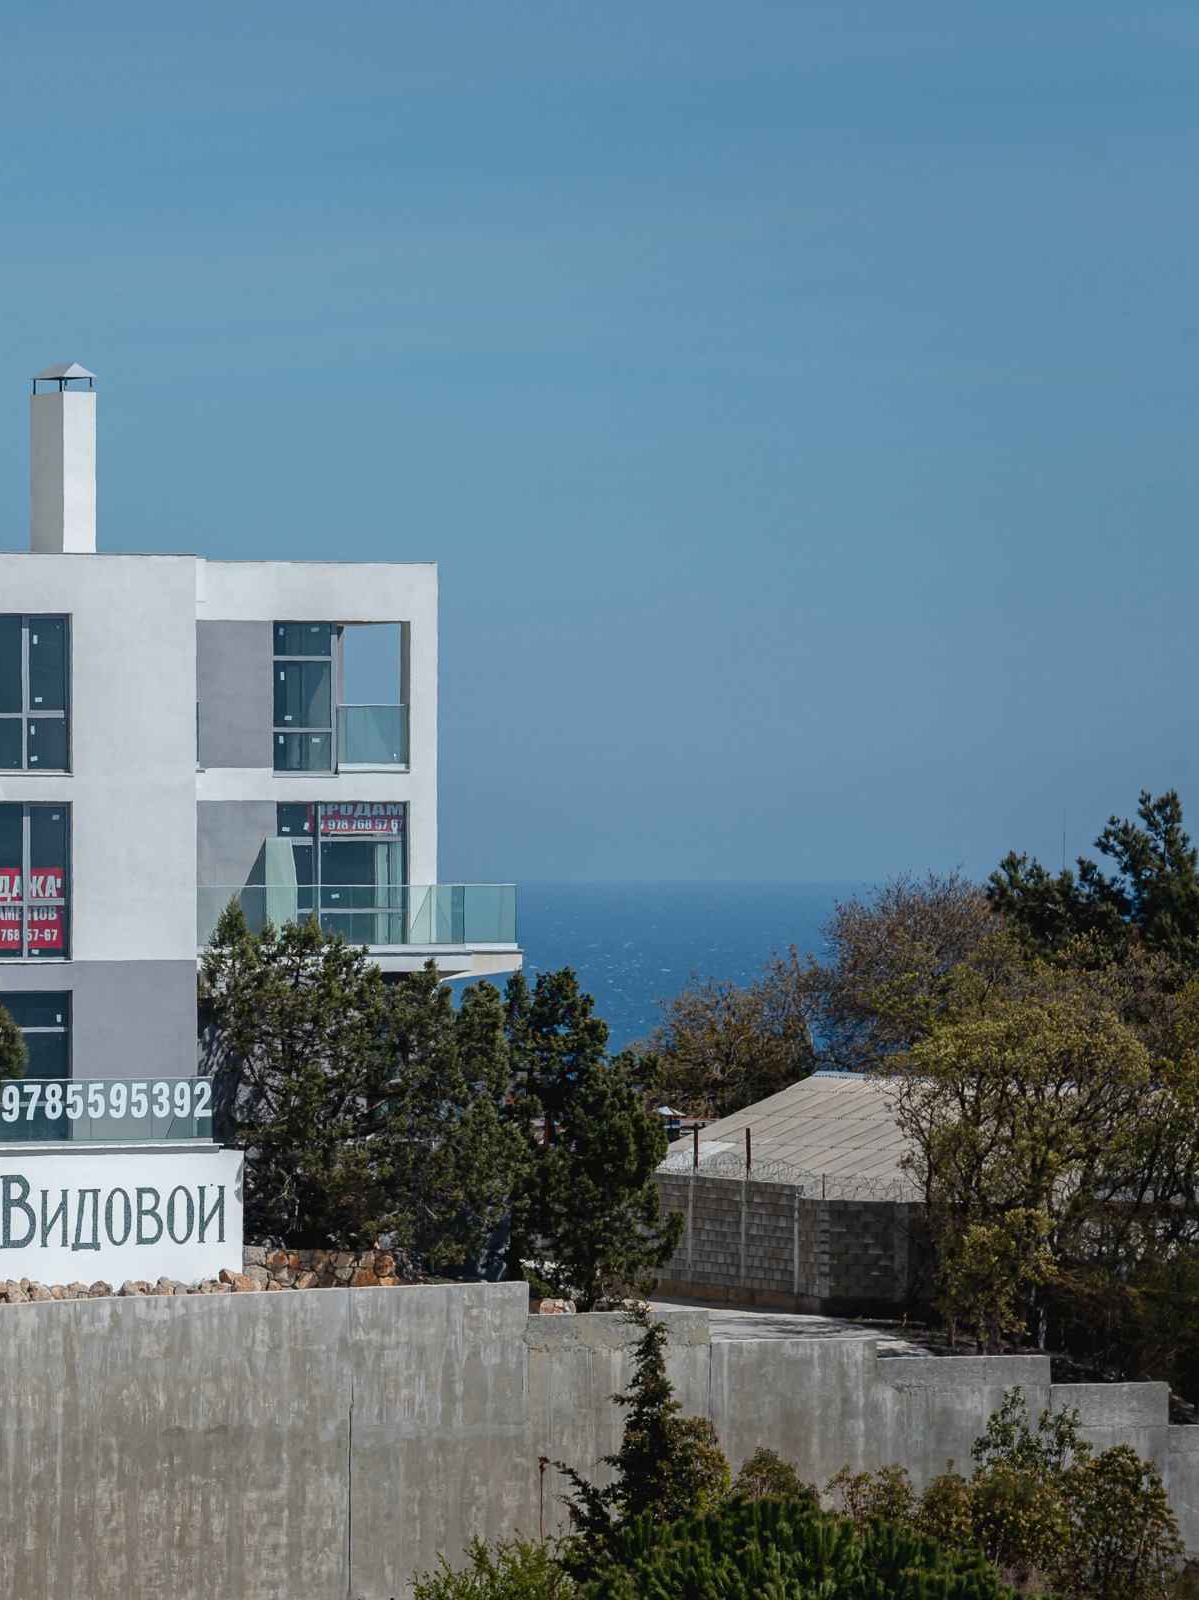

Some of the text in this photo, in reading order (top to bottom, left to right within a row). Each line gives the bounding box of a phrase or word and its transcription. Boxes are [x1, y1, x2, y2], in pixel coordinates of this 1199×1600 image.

[327, 820, 349, 830] 978
[351, 820, 372, 830] 768
[374, 820, 389, 830] 57
[2, 1081, 213, 1122] 9785595392
